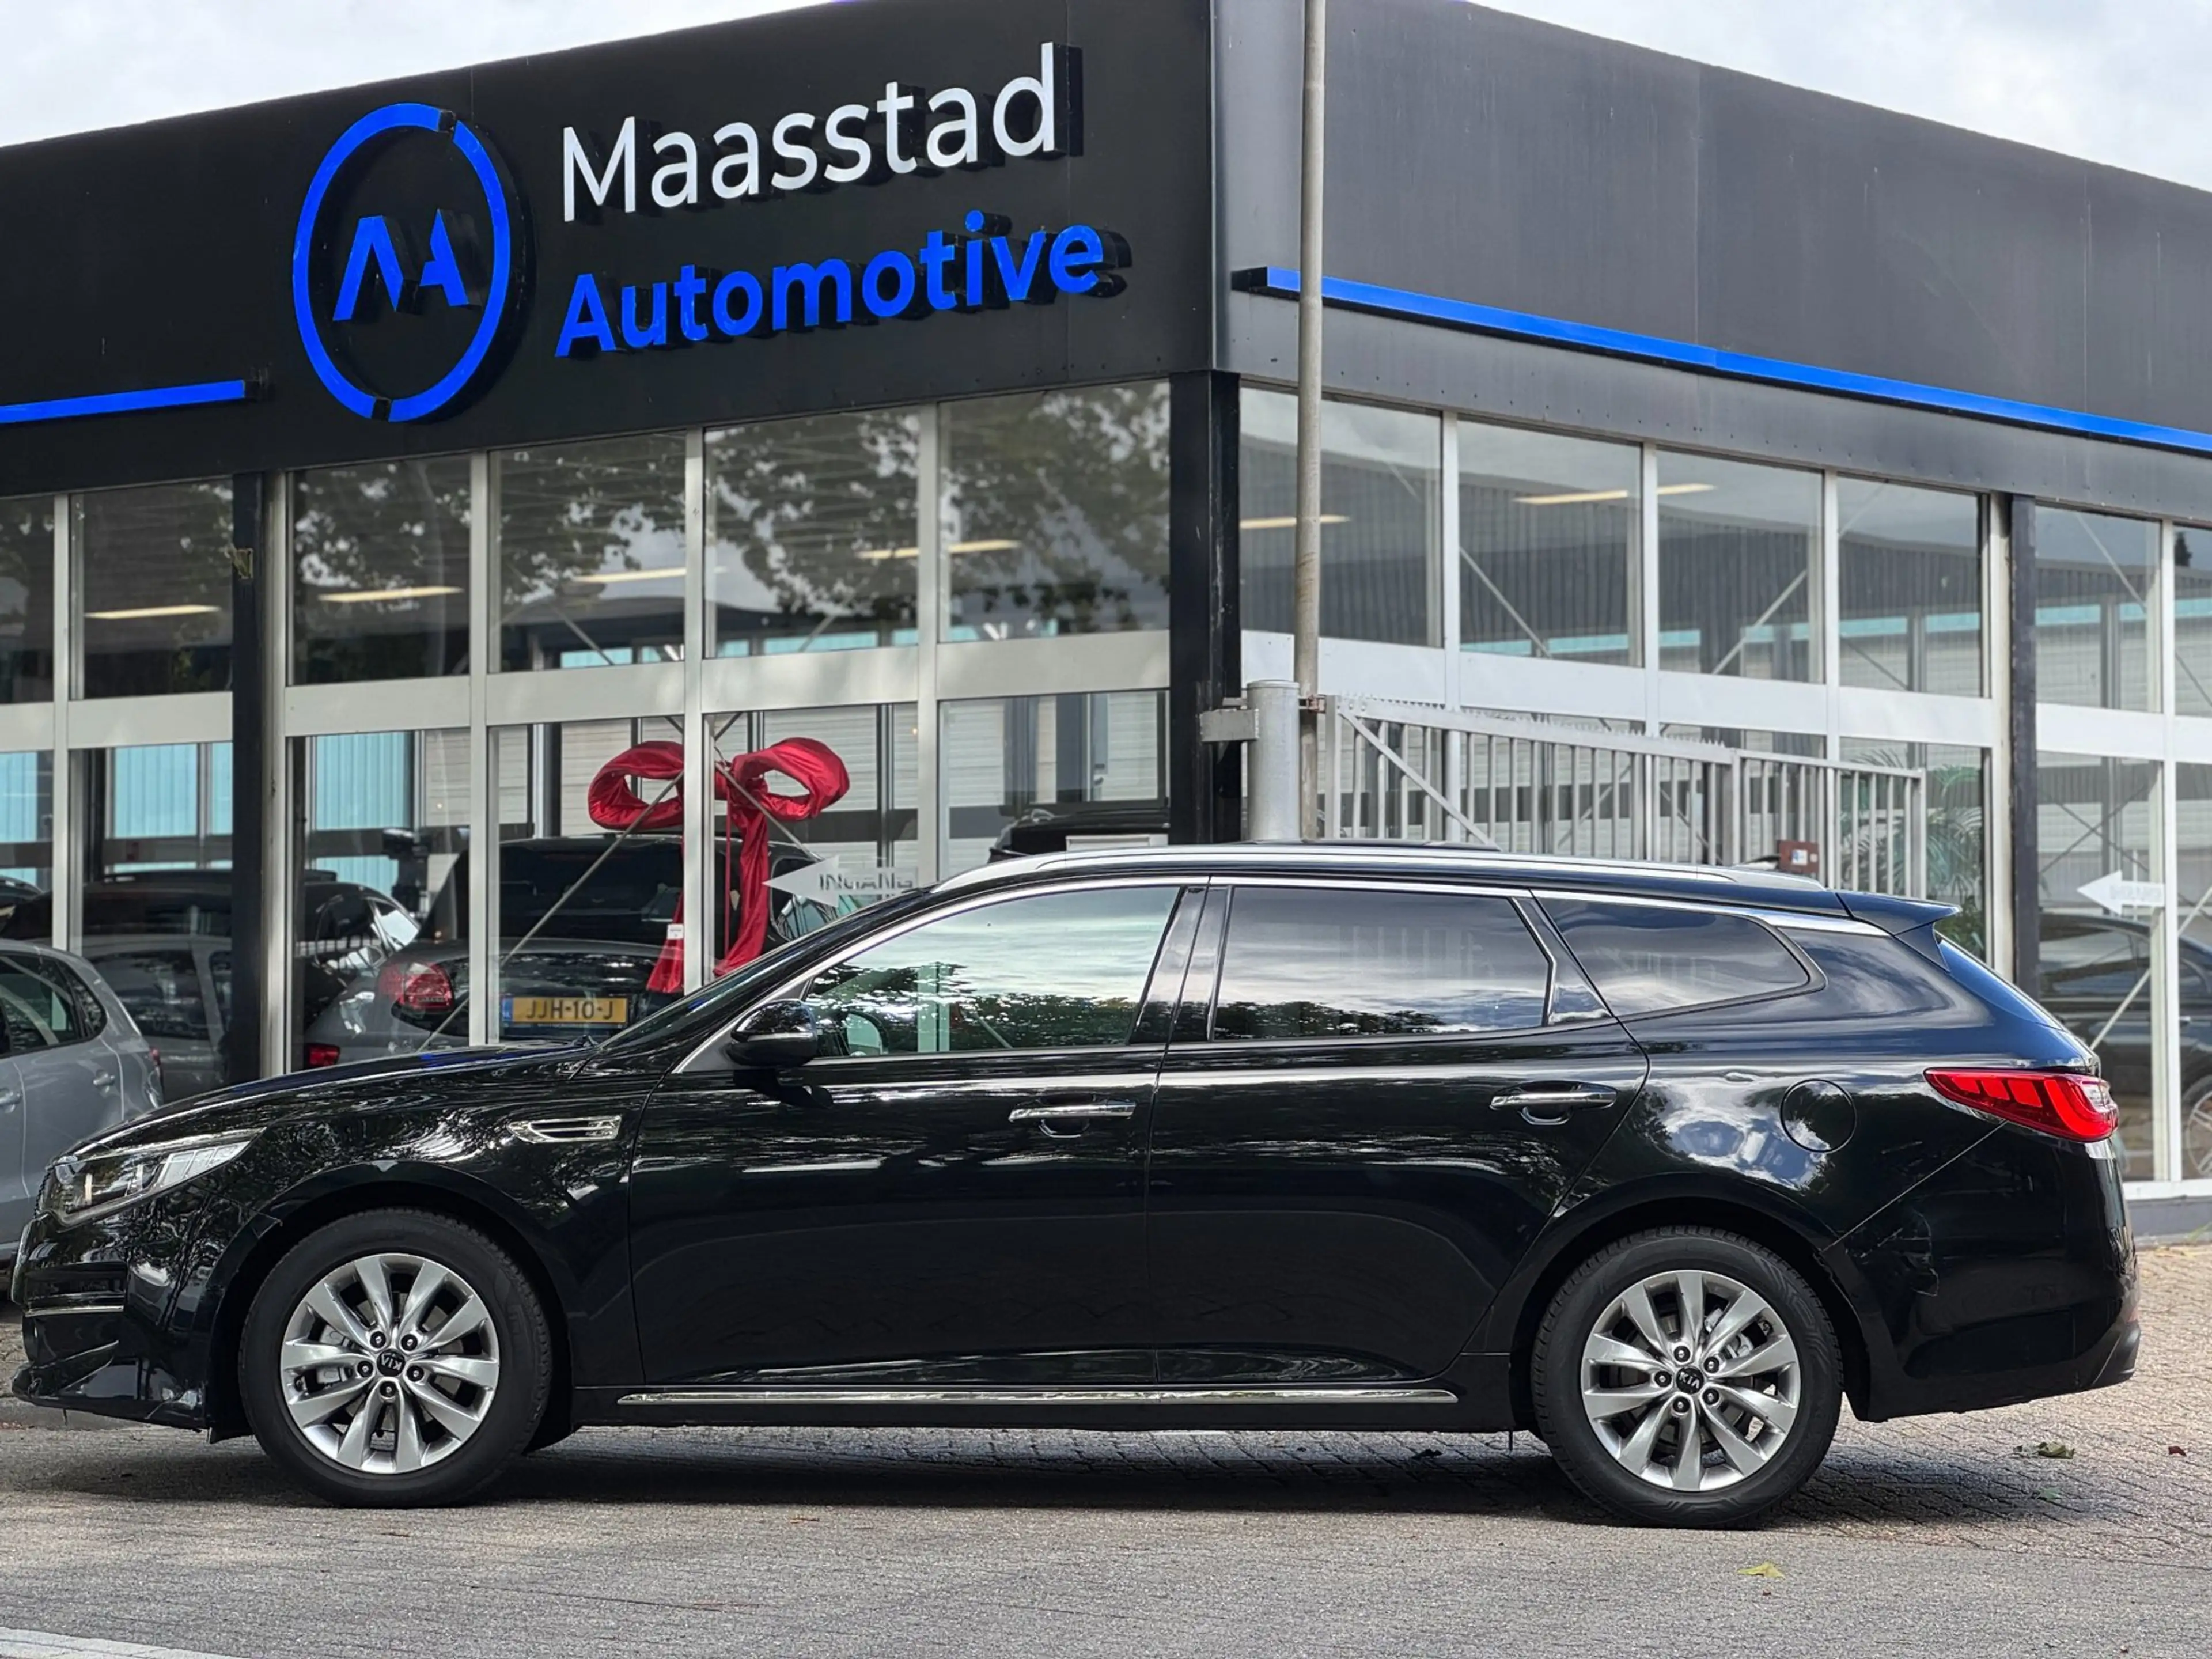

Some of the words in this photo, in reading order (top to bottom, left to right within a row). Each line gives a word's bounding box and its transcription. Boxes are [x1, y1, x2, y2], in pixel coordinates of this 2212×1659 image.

[563, 42, 1054, 222] Maasstad
[555, 210, 1104, 357] Automotive
[525, 999, 613, 1020] JJH-10-J
[381, 1352, 402, 1371] KIA
[1679, 1372, 1700, 1389] KIA
